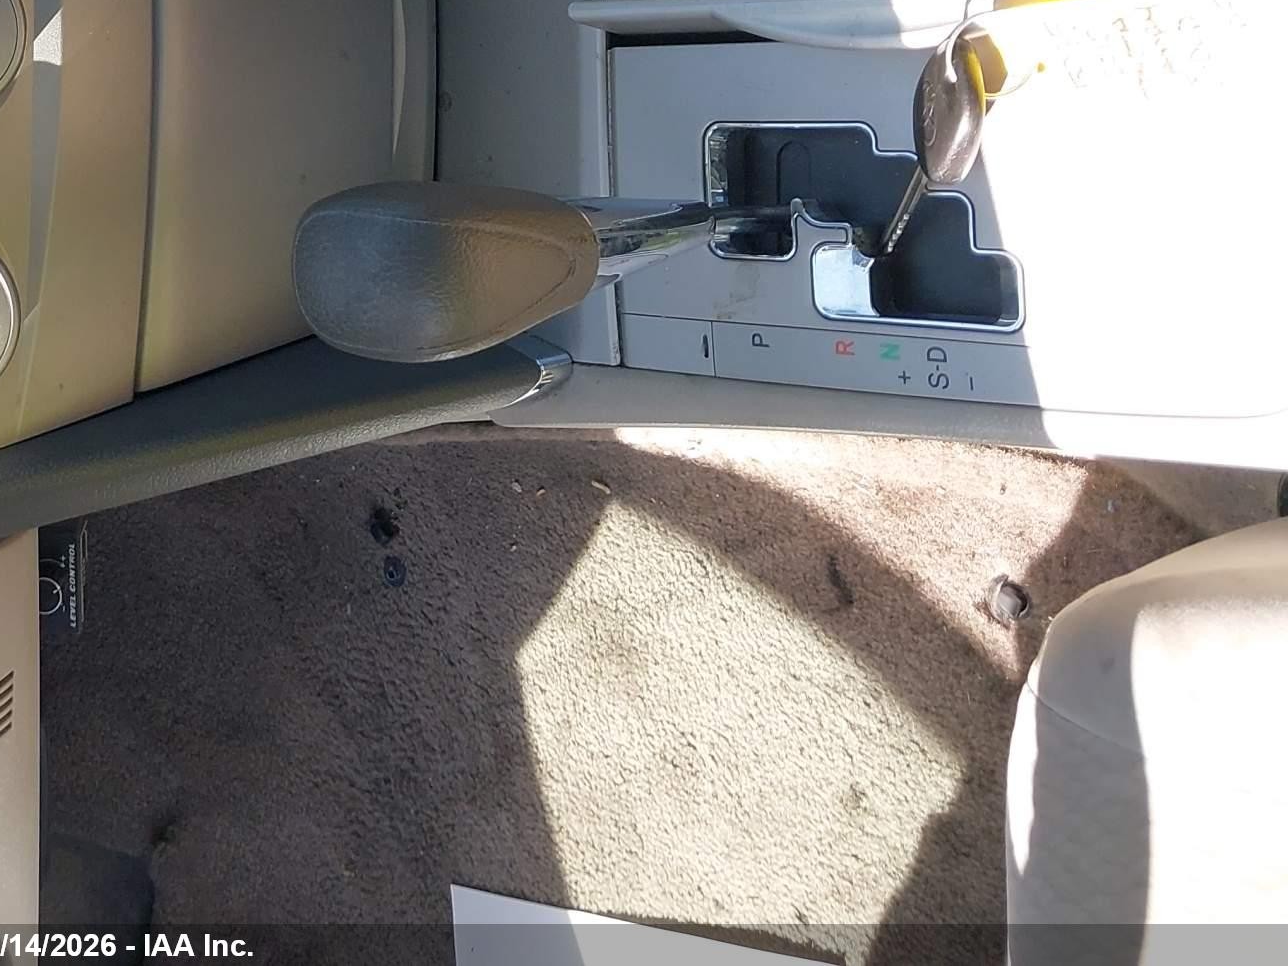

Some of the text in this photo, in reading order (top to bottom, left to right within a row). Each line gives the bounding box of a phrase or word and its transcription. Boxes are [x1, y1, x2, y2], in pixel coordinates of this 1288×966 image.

[752, 332, 770, 349] P
[835, 340, 855, 356] R
[879, 342, 901, 361] N
[68, 542, 77, 628] LEVEL CONTROL
